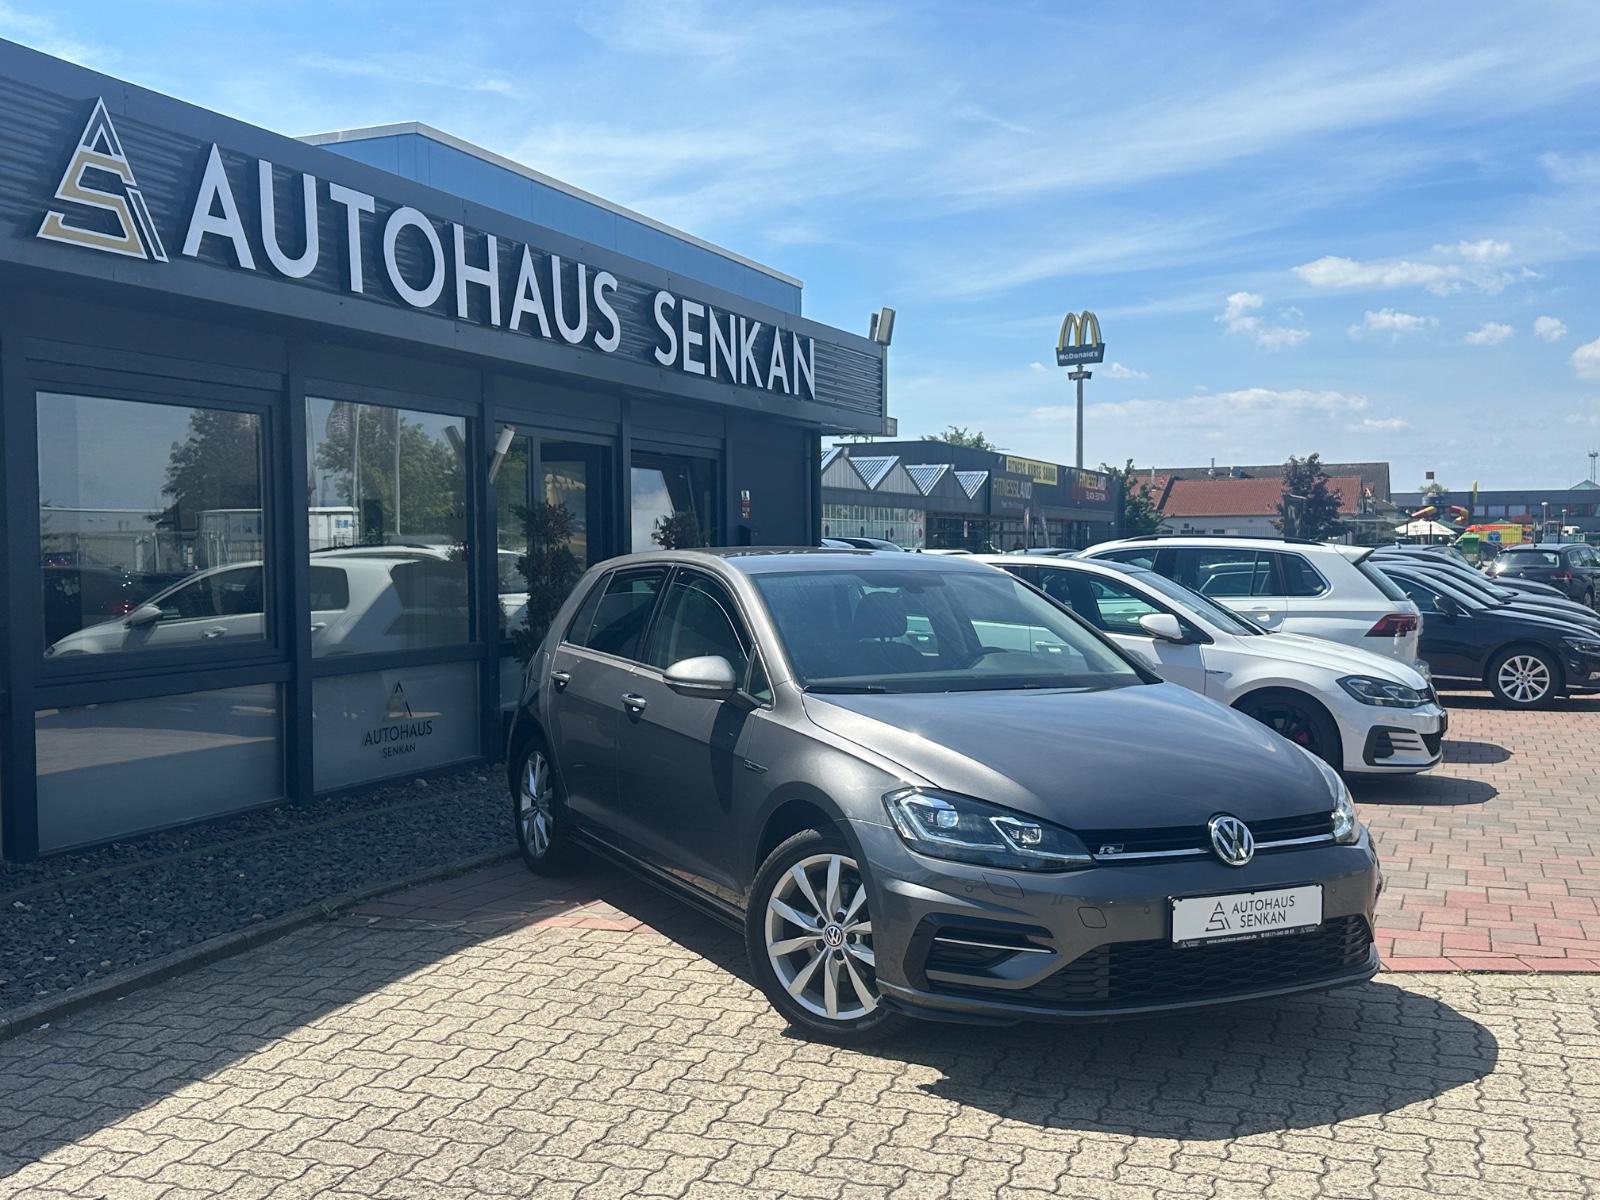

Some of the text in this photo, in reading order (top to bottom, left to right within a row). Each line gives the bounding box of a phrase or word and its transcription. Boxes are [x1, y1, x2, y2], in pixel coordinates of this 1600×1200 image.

[182, 142, 816, 400] AUTOHAUS SENKAN
[1059, 351, 1099, 361] McDonald's
[364, 720, 433, 746] AUTOHAUS
[382, 742, 416, 758] SENKAN
[1232, 895, 1295, 914] AUTOHAUS
[1240, 910, 1286, 929] SENKAN
